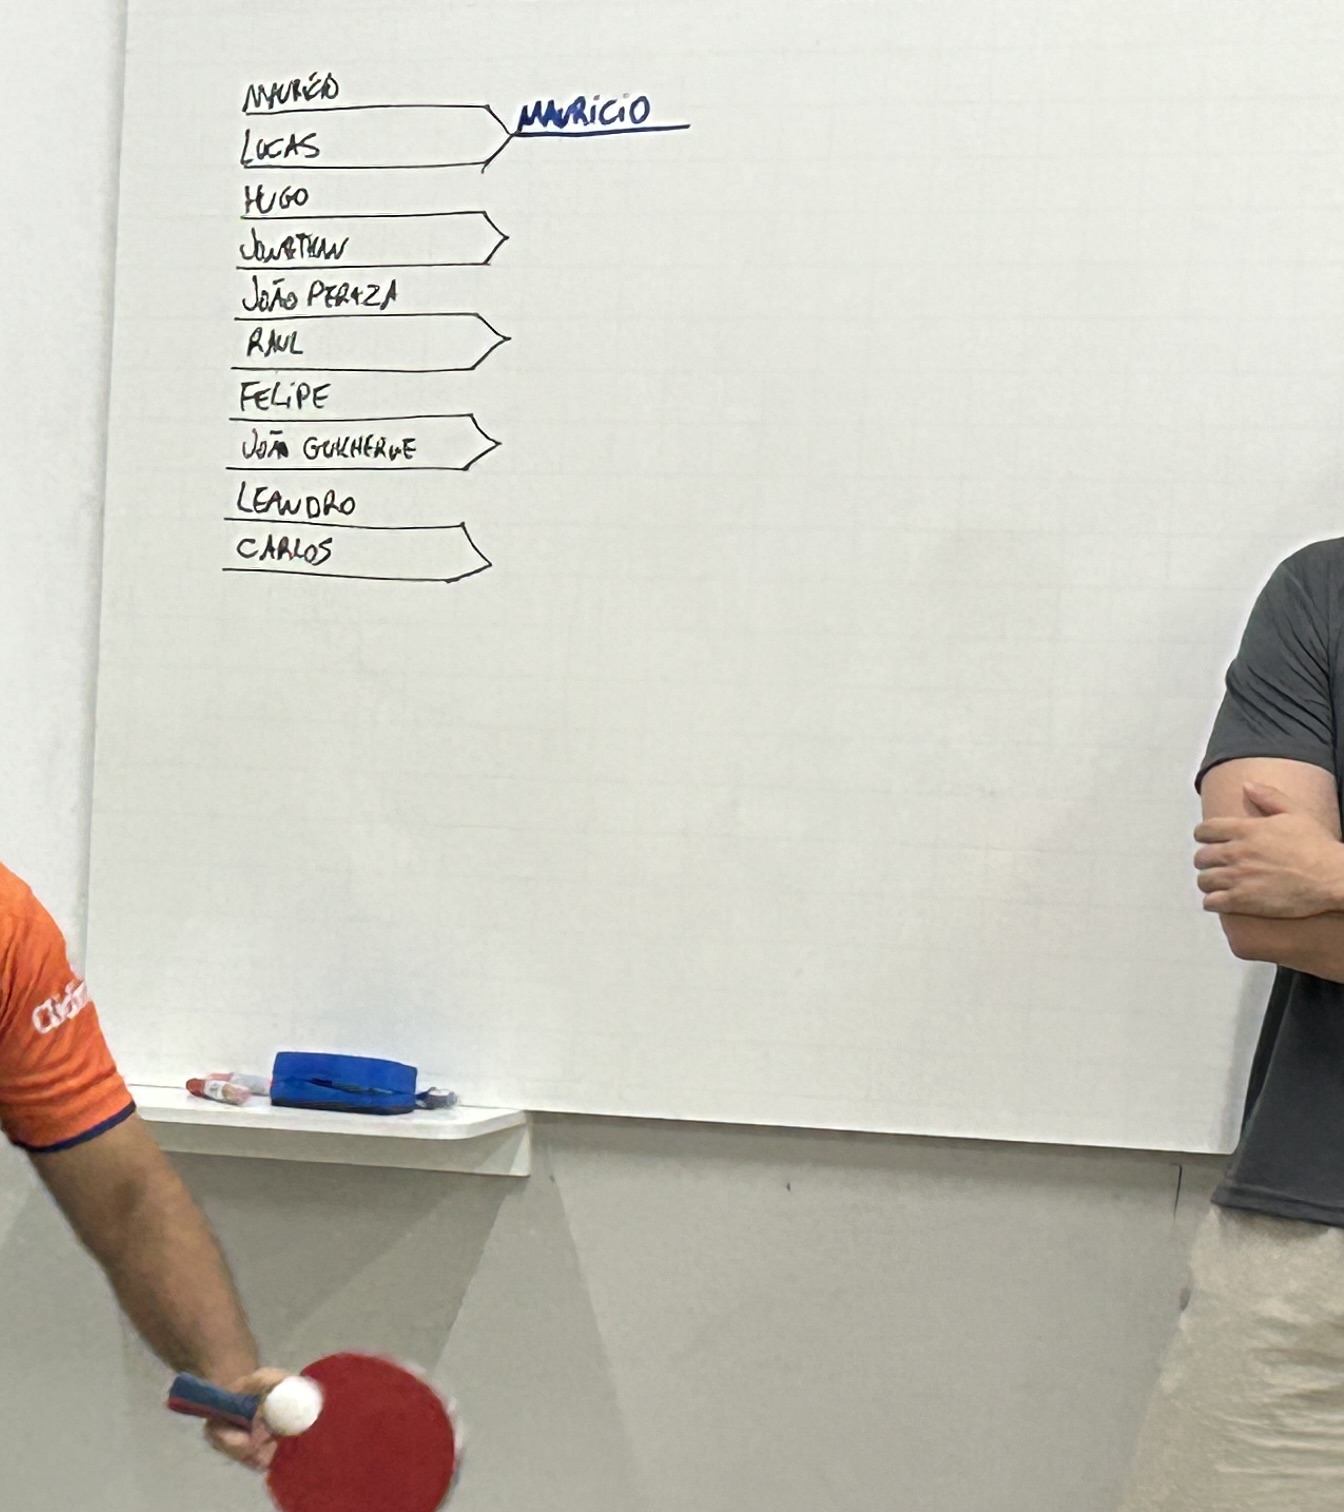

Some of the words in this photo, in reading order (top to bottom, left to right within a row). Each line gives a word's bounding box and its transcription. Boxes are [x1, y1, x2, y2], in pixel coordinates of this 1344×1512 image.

[240, 129, 320, 165] LUCAS
[244, 184, 309, 214] HUGO
[242, 275, 298, 312] JOÃO
[247, 326, 304, 357] RAUL
[240, 381, 331, 411] FELIPE
[237, 481, 355, 519] LEANDRO
[236, 534, 333, 566] CARLOS
